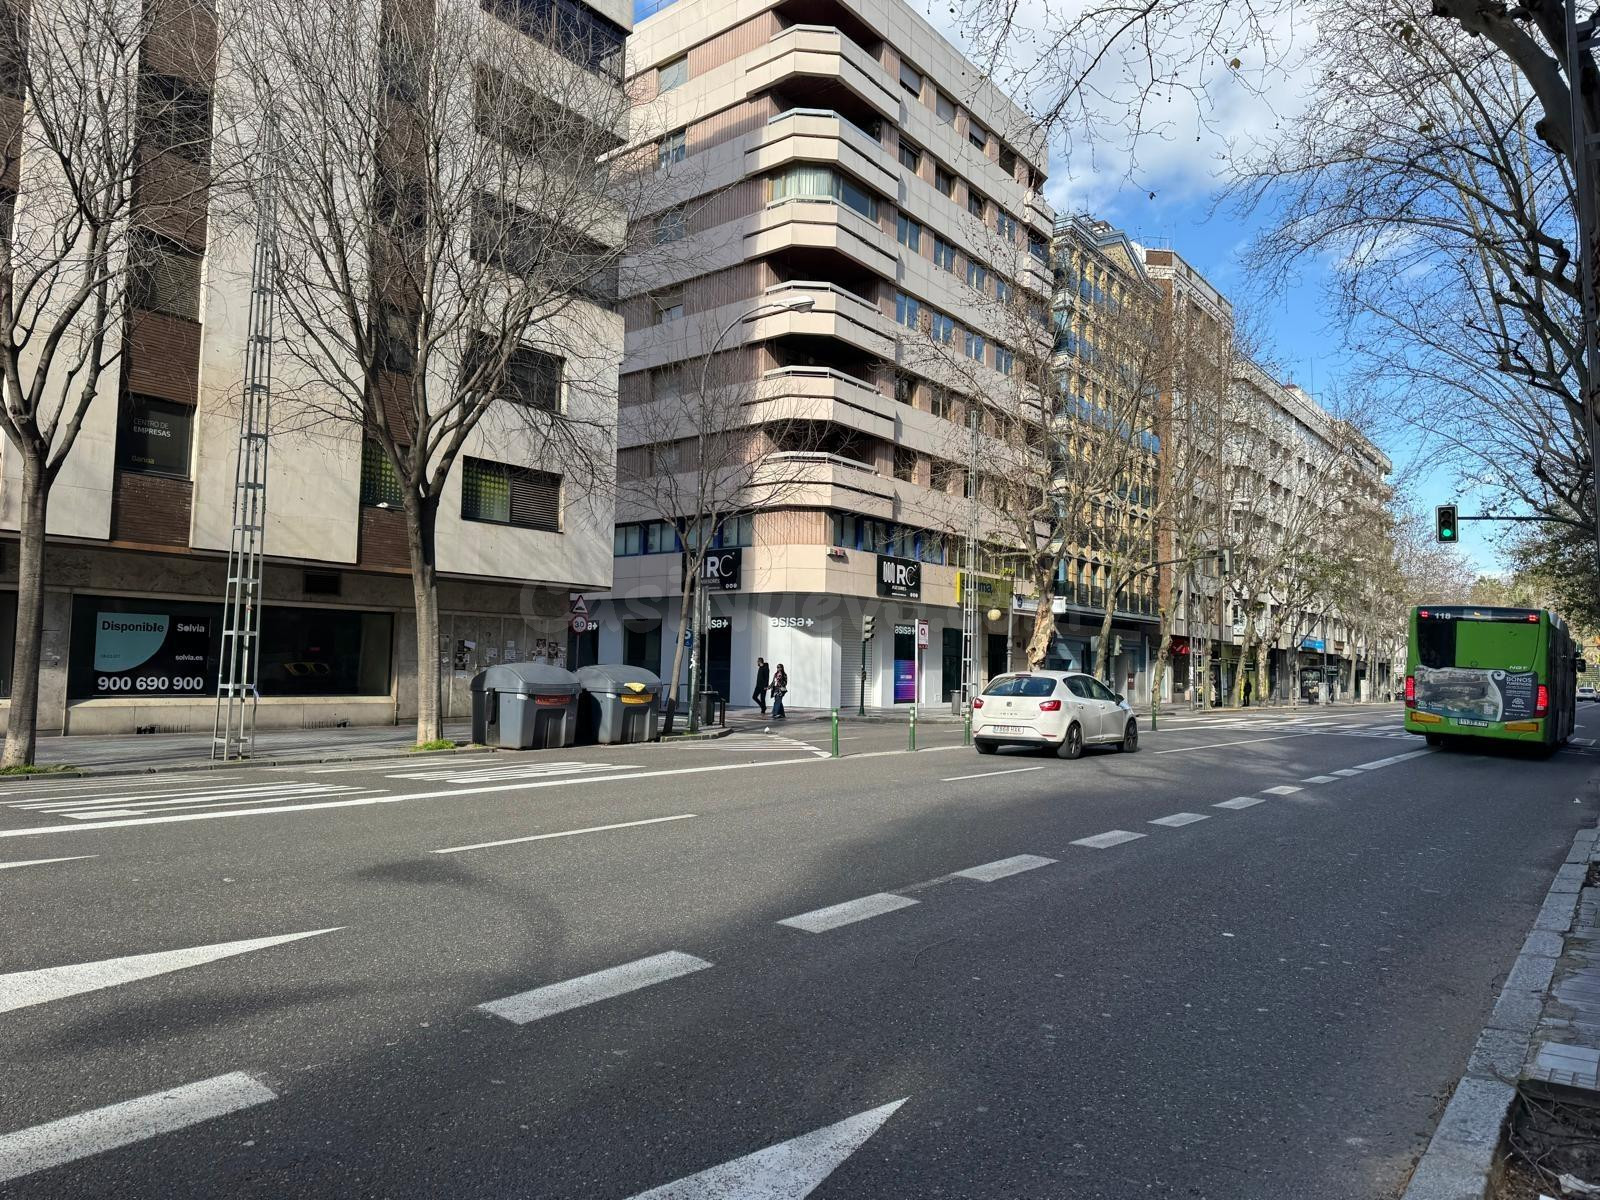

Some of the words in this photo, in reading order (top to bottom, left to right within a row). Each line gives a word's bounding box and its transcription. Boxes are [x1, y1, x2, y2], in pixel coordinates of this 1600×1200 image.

[133, 418, 160, 428] CENTRO
[160, 421, 169, 430] DE
[133, 425, 171, 438] EMPRESAS
[102, 621, 165, 633] Disponible
[177, 623, 205, 633] Solvia
[575, 620, 585, 628] 30
[175, 653, 203, 662] solvia.es
[97, 676, 132, 691] 900
[136, 676, 169, 691] 690
[173, 676, 204, 691] 900
